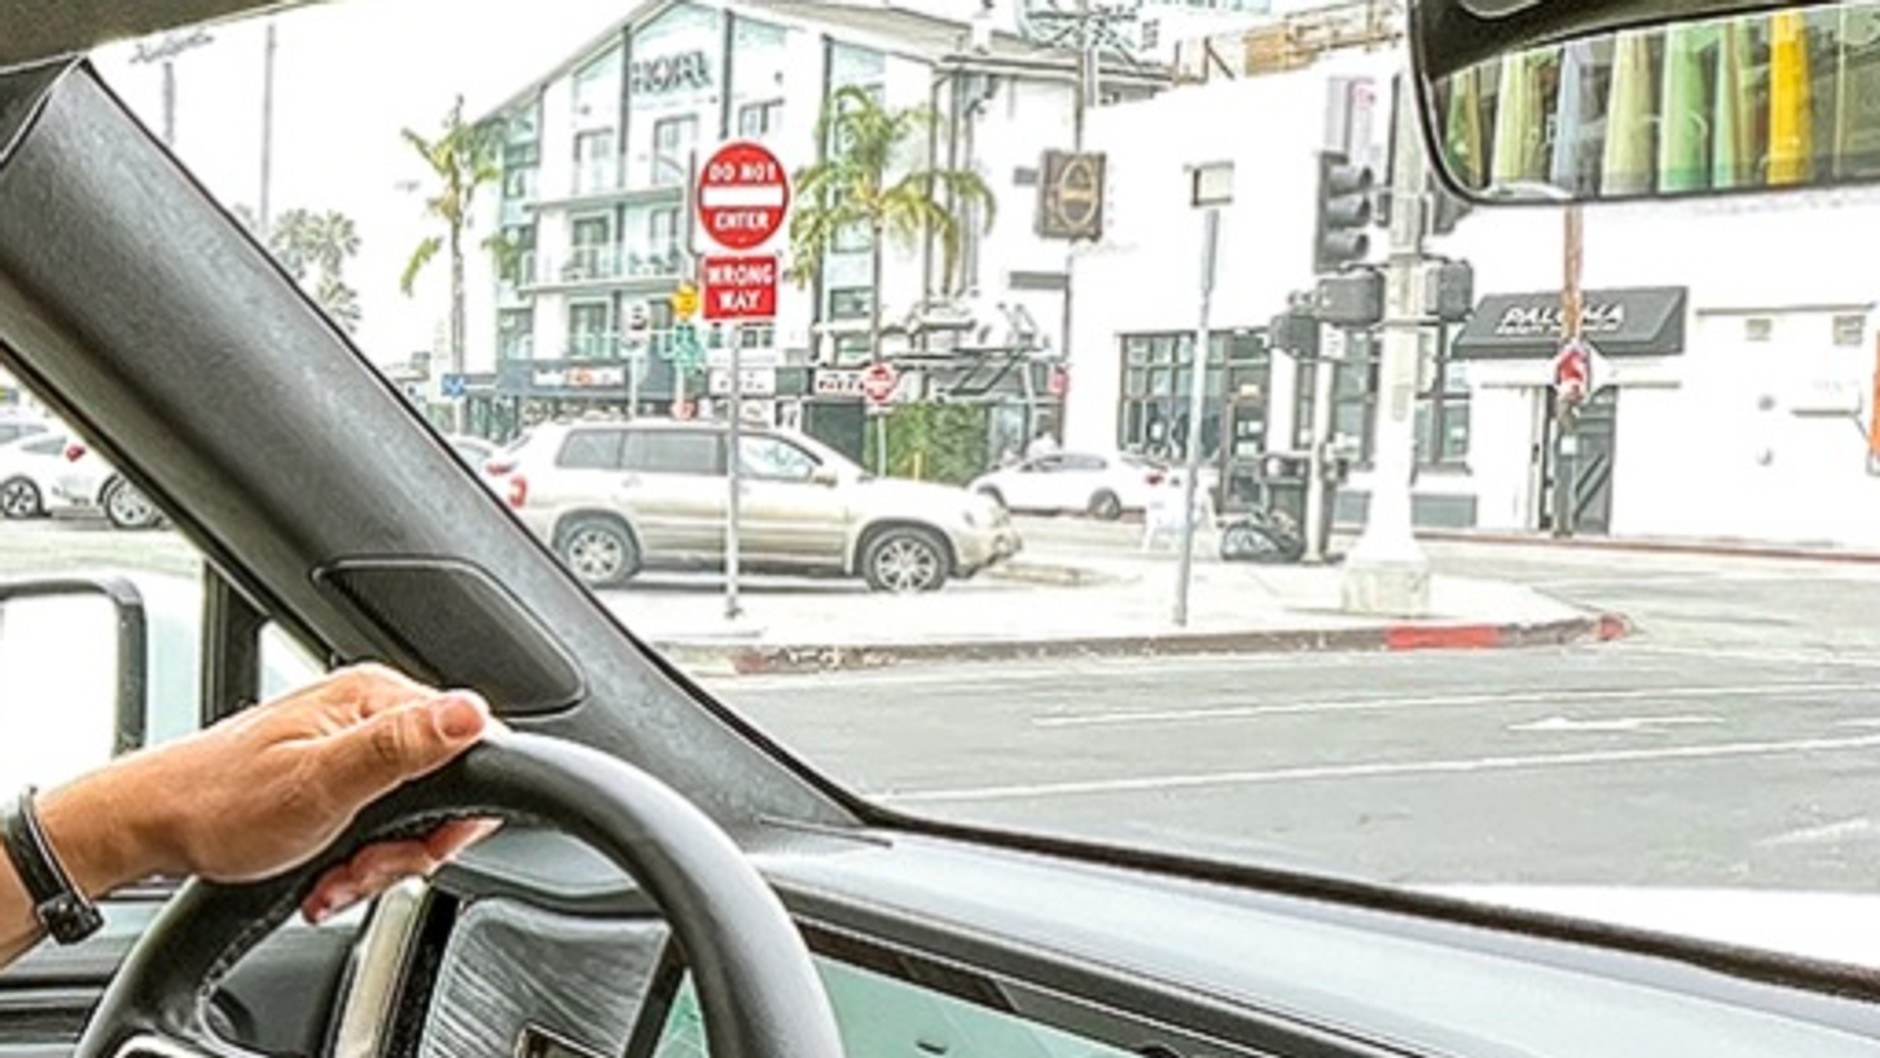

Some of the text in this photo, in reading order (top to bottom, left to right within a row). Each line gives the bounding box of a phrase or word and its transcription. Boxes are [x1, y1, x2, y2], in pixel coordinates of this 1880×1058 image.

[708, 162, 776, 181] DO NOT
[714, 212, 769, 231] ENTER
[708, 264, 773, 285] WRONG
[718, 291, 763, 310] WAY
